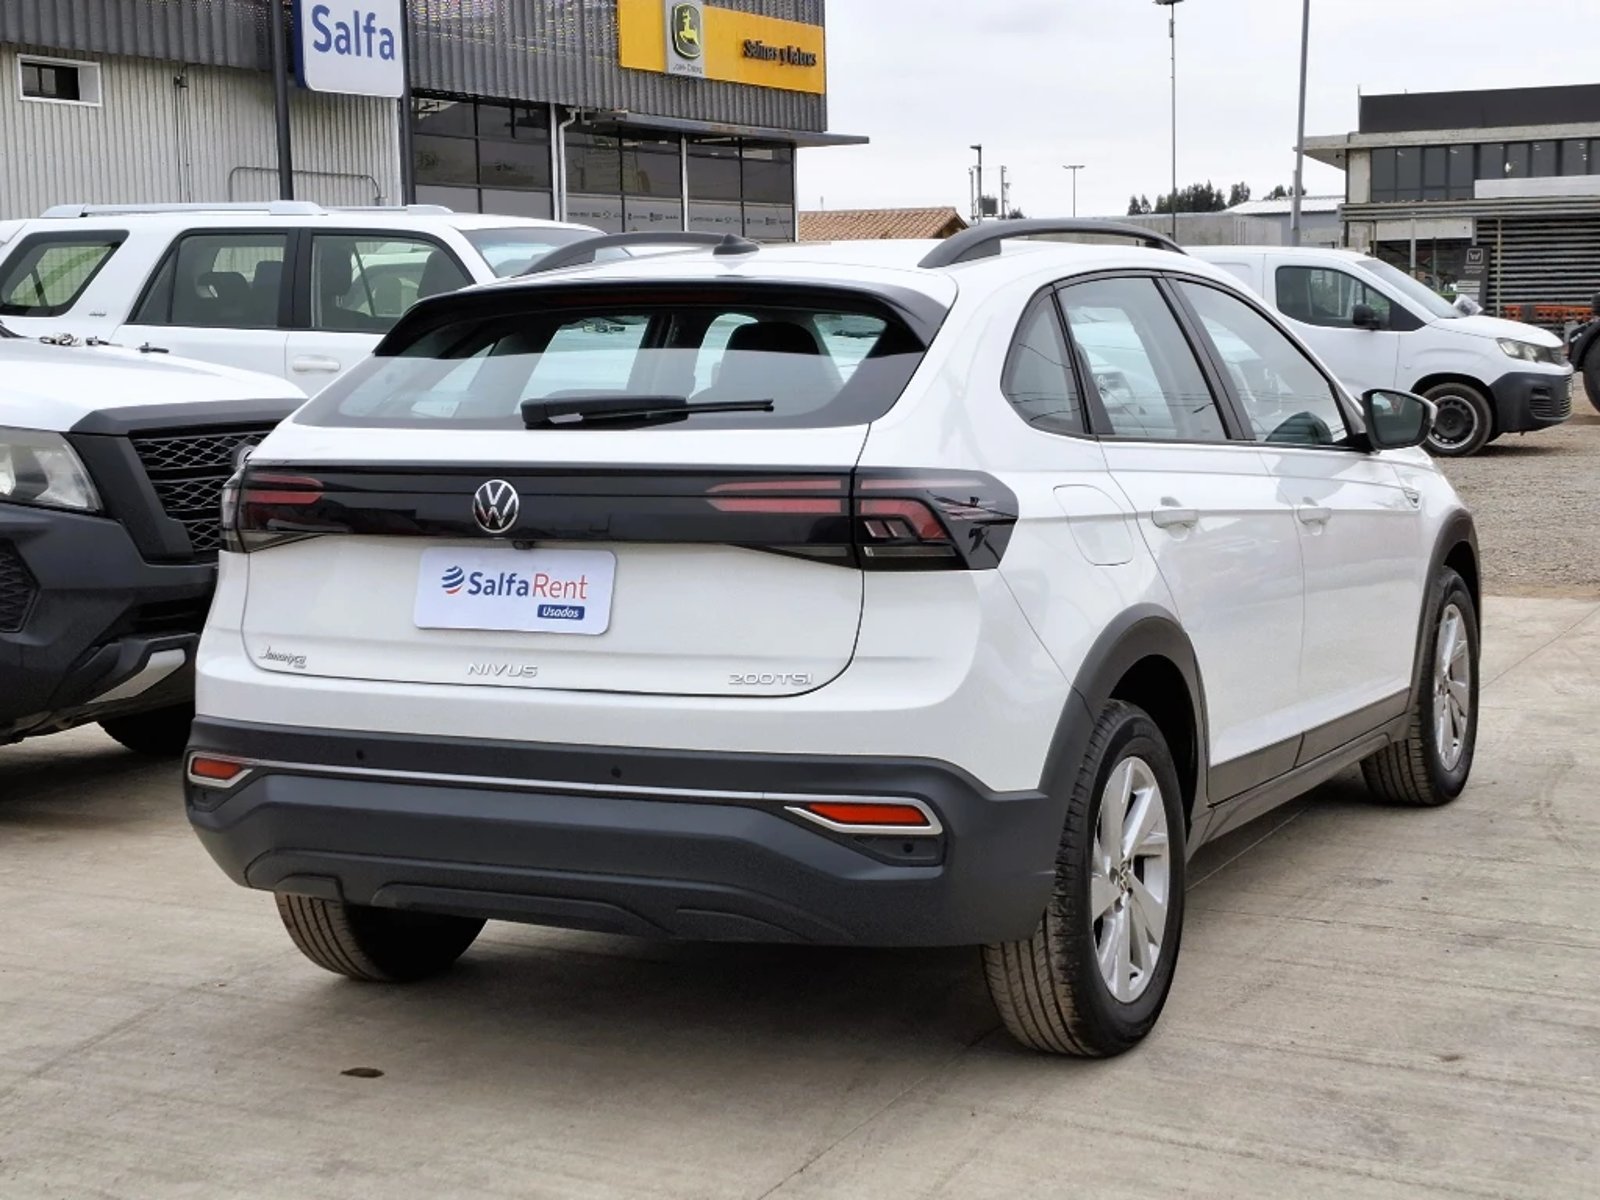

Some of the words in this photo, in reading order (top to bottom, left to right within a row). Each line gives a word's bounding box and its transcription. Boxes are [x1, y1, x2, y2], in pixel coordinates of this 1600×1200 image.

[311, 4, 395, 61] Salfa
[542, 605, 579, 618] Usados
[466, 662, 538, 678] NIVUS
